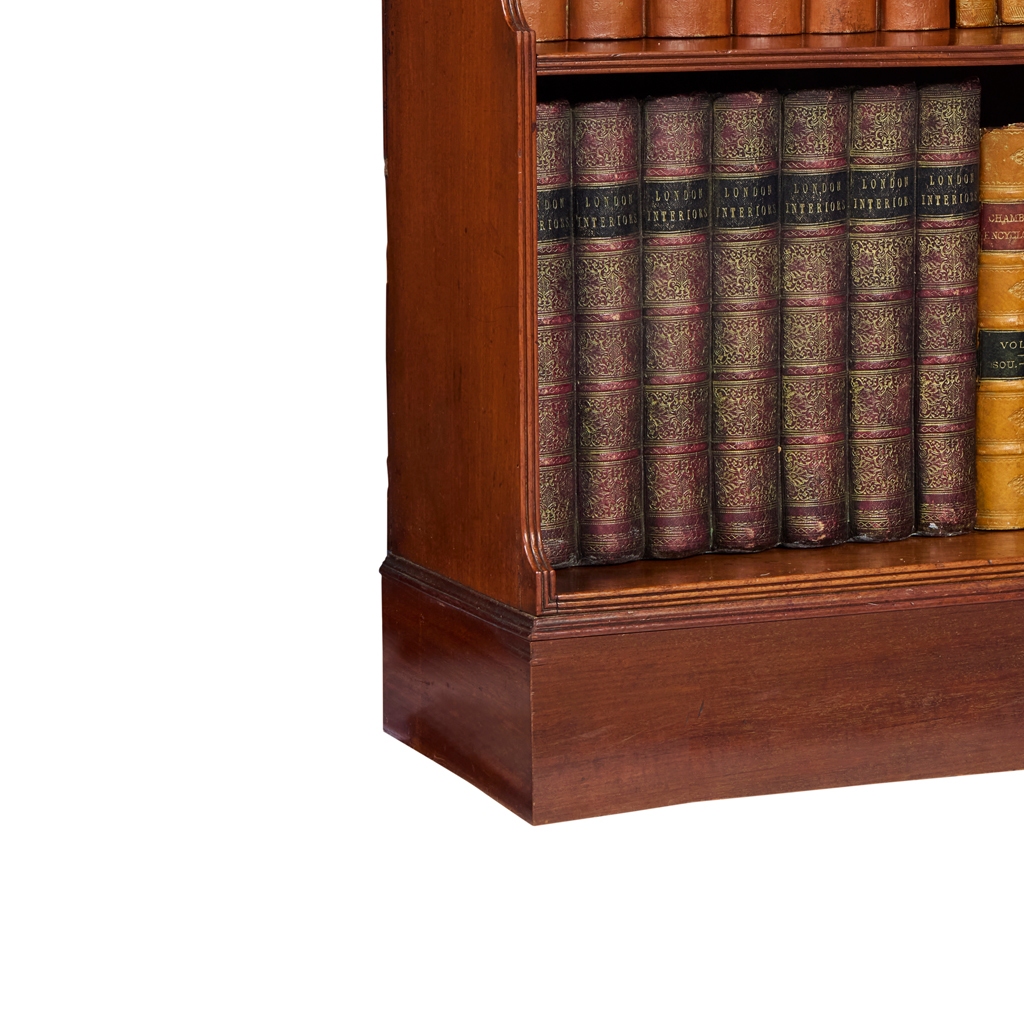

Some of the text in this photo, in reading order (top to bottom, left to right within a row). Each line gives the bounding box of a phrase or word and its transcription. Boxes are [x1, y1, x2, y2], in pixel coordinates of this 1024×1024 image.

[862, 176, 909, 190] LONDON
[929, 173, 974, 186] LONDON
[724, 185, 772, 198] LONDON
[794, 181, 841, 194] LONDON
[585, 194, 634, 208] LONDON
[655, 188, 704, 202] LONDON
[921, 192, 978, 206] INTERIORS
[786, 199, 846, 214] INTERIORS
[854, 196, 912, 210] INTERIORS
[647, 207, 708, 222] INTERIORS
[716, 203, 776, 218] INTERIORS
[578, 213, 638, 228] INTERIORS
